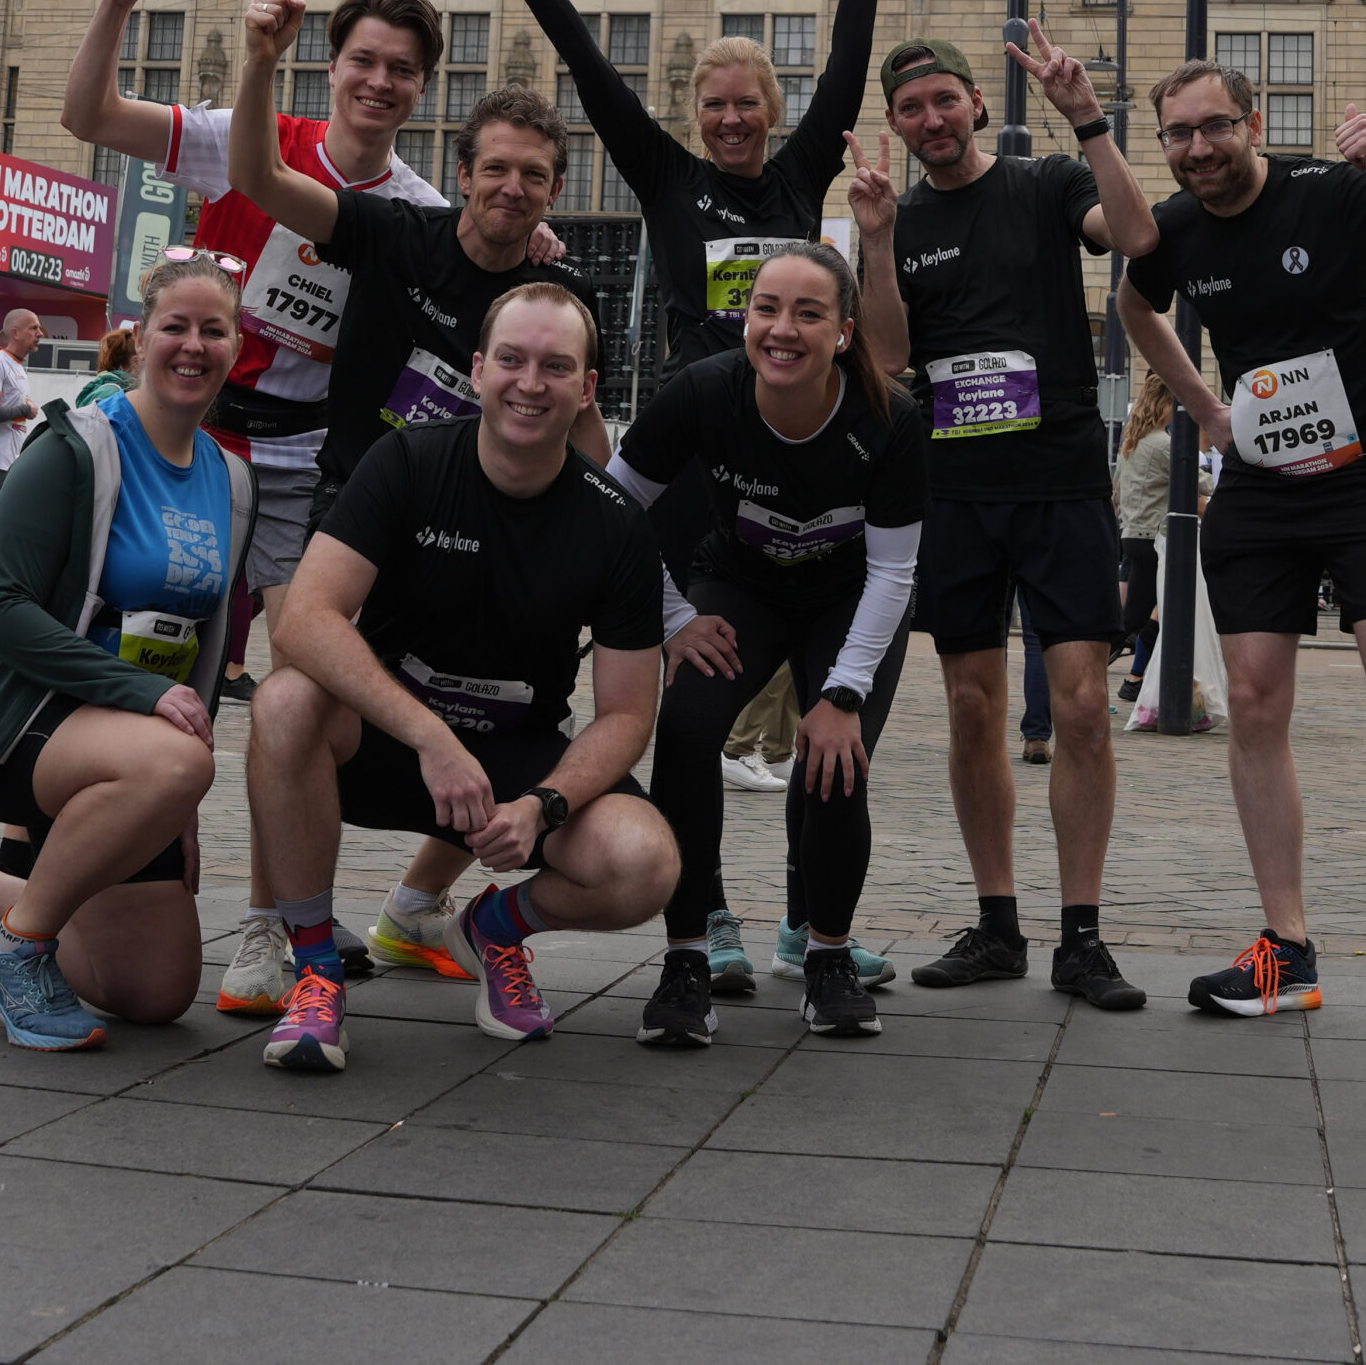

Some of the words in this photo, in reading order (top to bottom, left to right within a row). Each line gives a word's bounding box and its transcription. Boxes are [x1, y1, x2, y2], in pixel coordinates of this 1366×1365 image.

[4, 166, 108, 224] MARATHON
[11, 249, 63, 281] 00:27:23
[920, 246, 961, 268] Keylane
[288, 274, 333, 303] CHIEL
[1197, 276, 1232, 297] Keylane
[266, 288, 339, 333] 17977
[422, 297, 457, 328] Keylane
[259, 329, 297, 352] ROTTERDAM
[276, 329, 312, 348] MARATHON
[979, 357, 1007, 370] GOLAZO
[955, 375, 1006, 388] EXCHANGE
[1280, 367, 1309, 385] NN
[958, 389, 1005, 402] Keylane
[952, 400, 1017, 425] 32223
[1259, 401, 1319, 426] ARJAN
[846, 433, 866, 456] CRAFT
[1254, 419, 1335, 455] 17969
[1291, 458, 1327, 471] MARATHON
[584, 472, 618, 499] CRAFT
[733, 473, 779, 497] Keylane
[436, 530, 480, 553] Keylane
[465, 681, 500, 696] GOLAZO
[428, 697, 485, 716] Keylane
